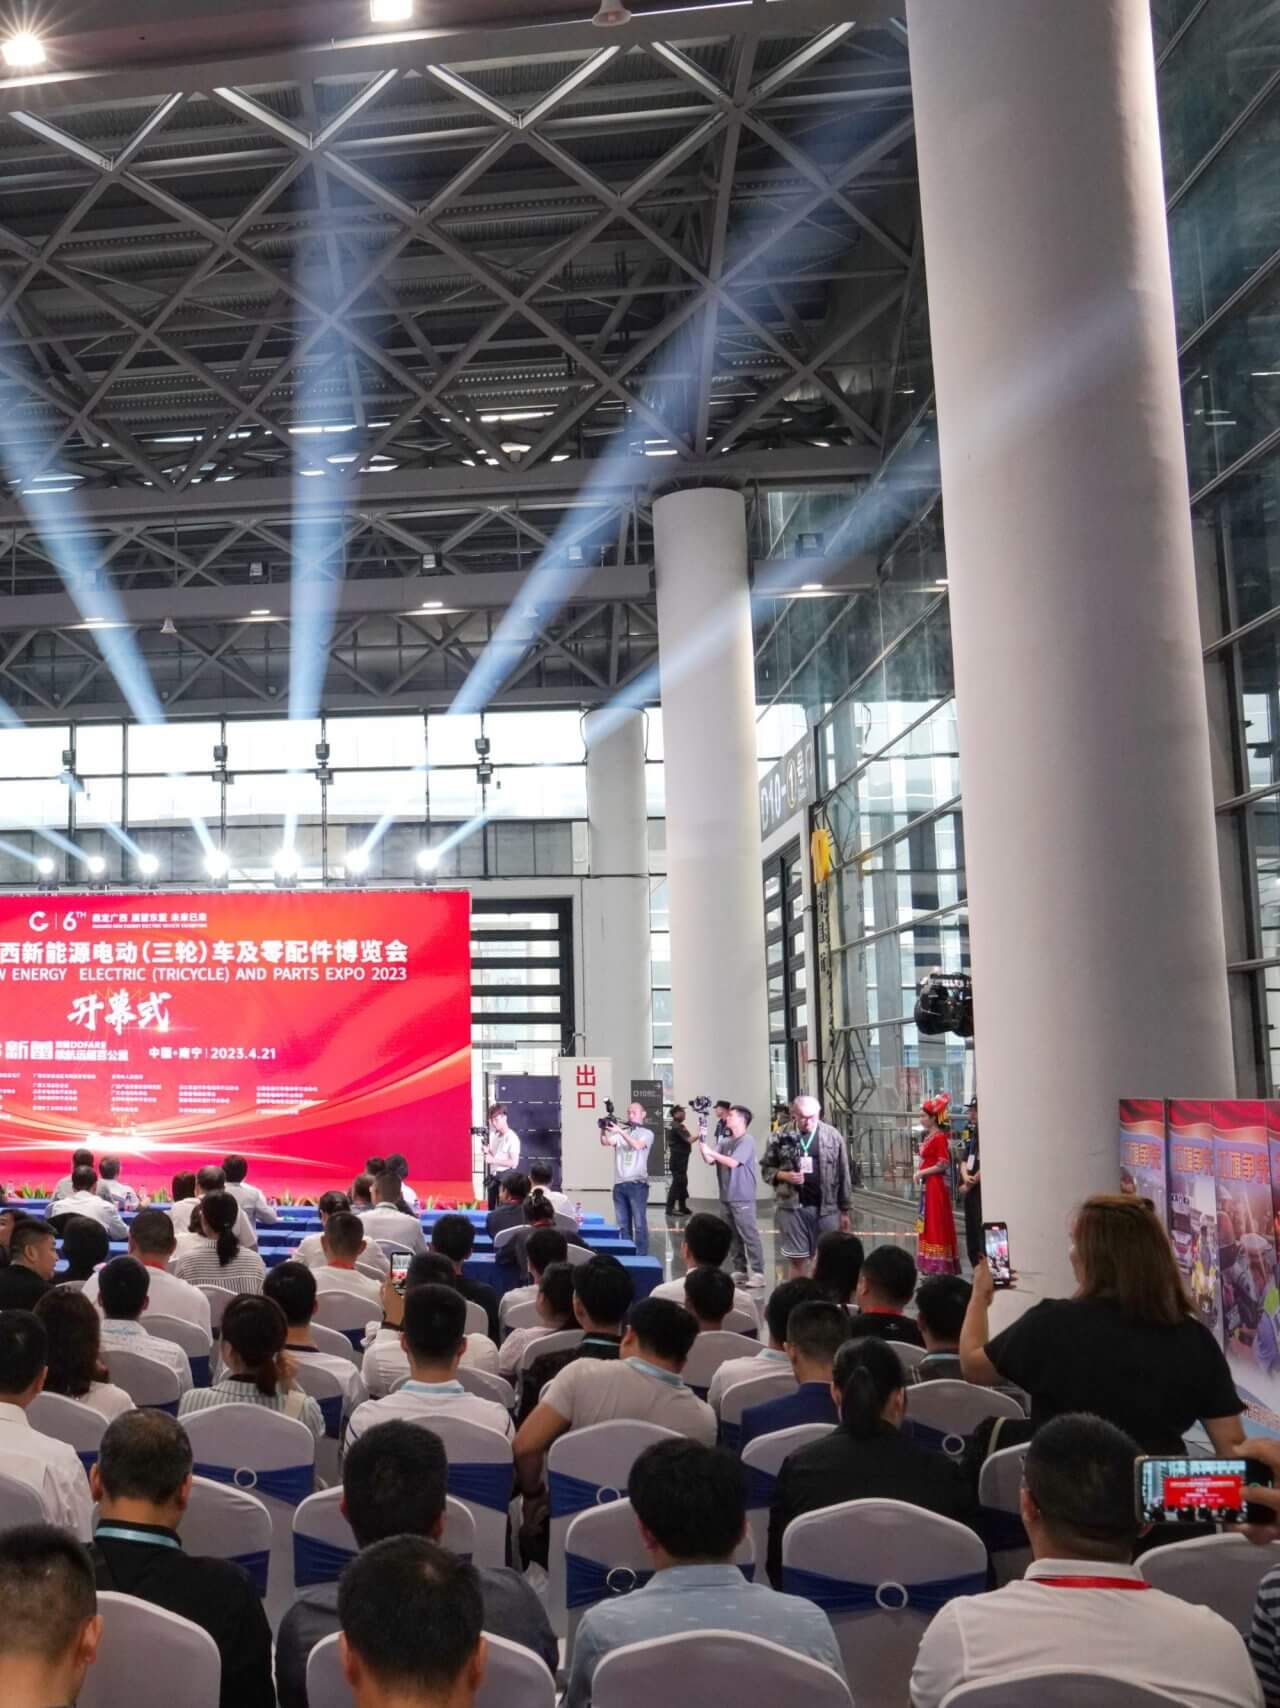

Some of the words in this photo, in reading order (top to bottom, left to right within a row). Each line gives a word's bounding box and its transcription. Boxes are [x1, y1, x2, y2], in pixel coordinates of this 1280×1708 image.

[12, 968, 67, 981] ENERGY
[79, 968, 145, 981] ELECTRIC
[152, 967, 230, 983] (TRICYCLE)
[235, 967, 267, 981] AND
[273, 967, 320, 981] PARTS
[325, 967, 365, 981] EXPO
[371, 967, 407, 981] 2023
[67, 988, 172, 1035] 开幕式
[210, 1047, 276, 1060] 2023.4.21
[576, 1064, 596, 1108] 出口
